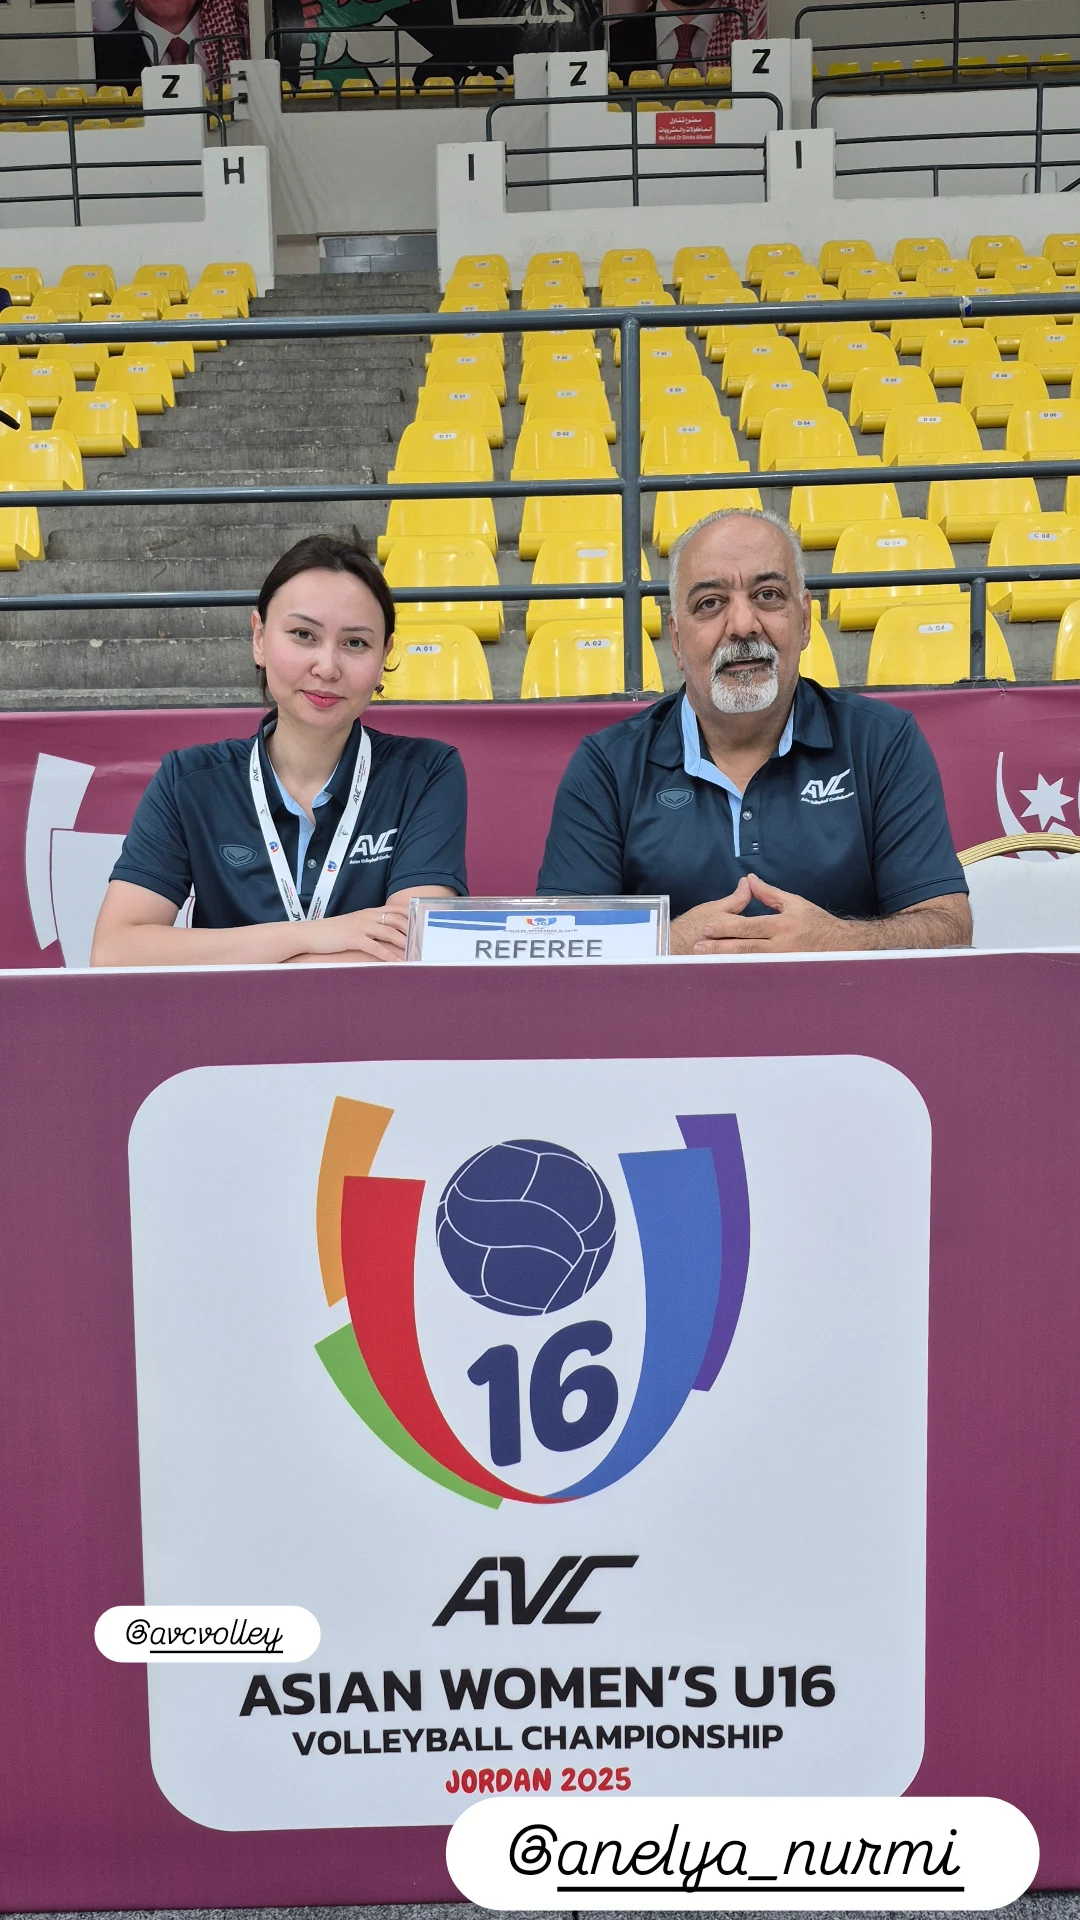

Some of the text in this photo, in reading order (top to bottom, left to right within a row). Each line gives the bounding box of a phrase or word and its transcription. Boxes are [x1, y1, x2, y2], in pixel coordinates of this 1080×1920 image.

[569, 60, 588, 87] Z
[751, 48, 771, 74] Z
[161, 74, 181, 99] Z
[222, 156, 245, 185] H
[800, 768, 850, 798] AVC
[349, 828, 398, 858] AVC
[475, 939, 603, 959] REFEREE
[467, 1320, 618, 1467] 16
[432, 1555, 640, 1627] AVC
[239, 1665, 836, 1717] ASIAN WOMEN'S U16
[292, 1724, 784, 1756] VOLLEYBALL CHAMPIONSHIP
[446, 1767, 632, 1795] JORDAN 2025
